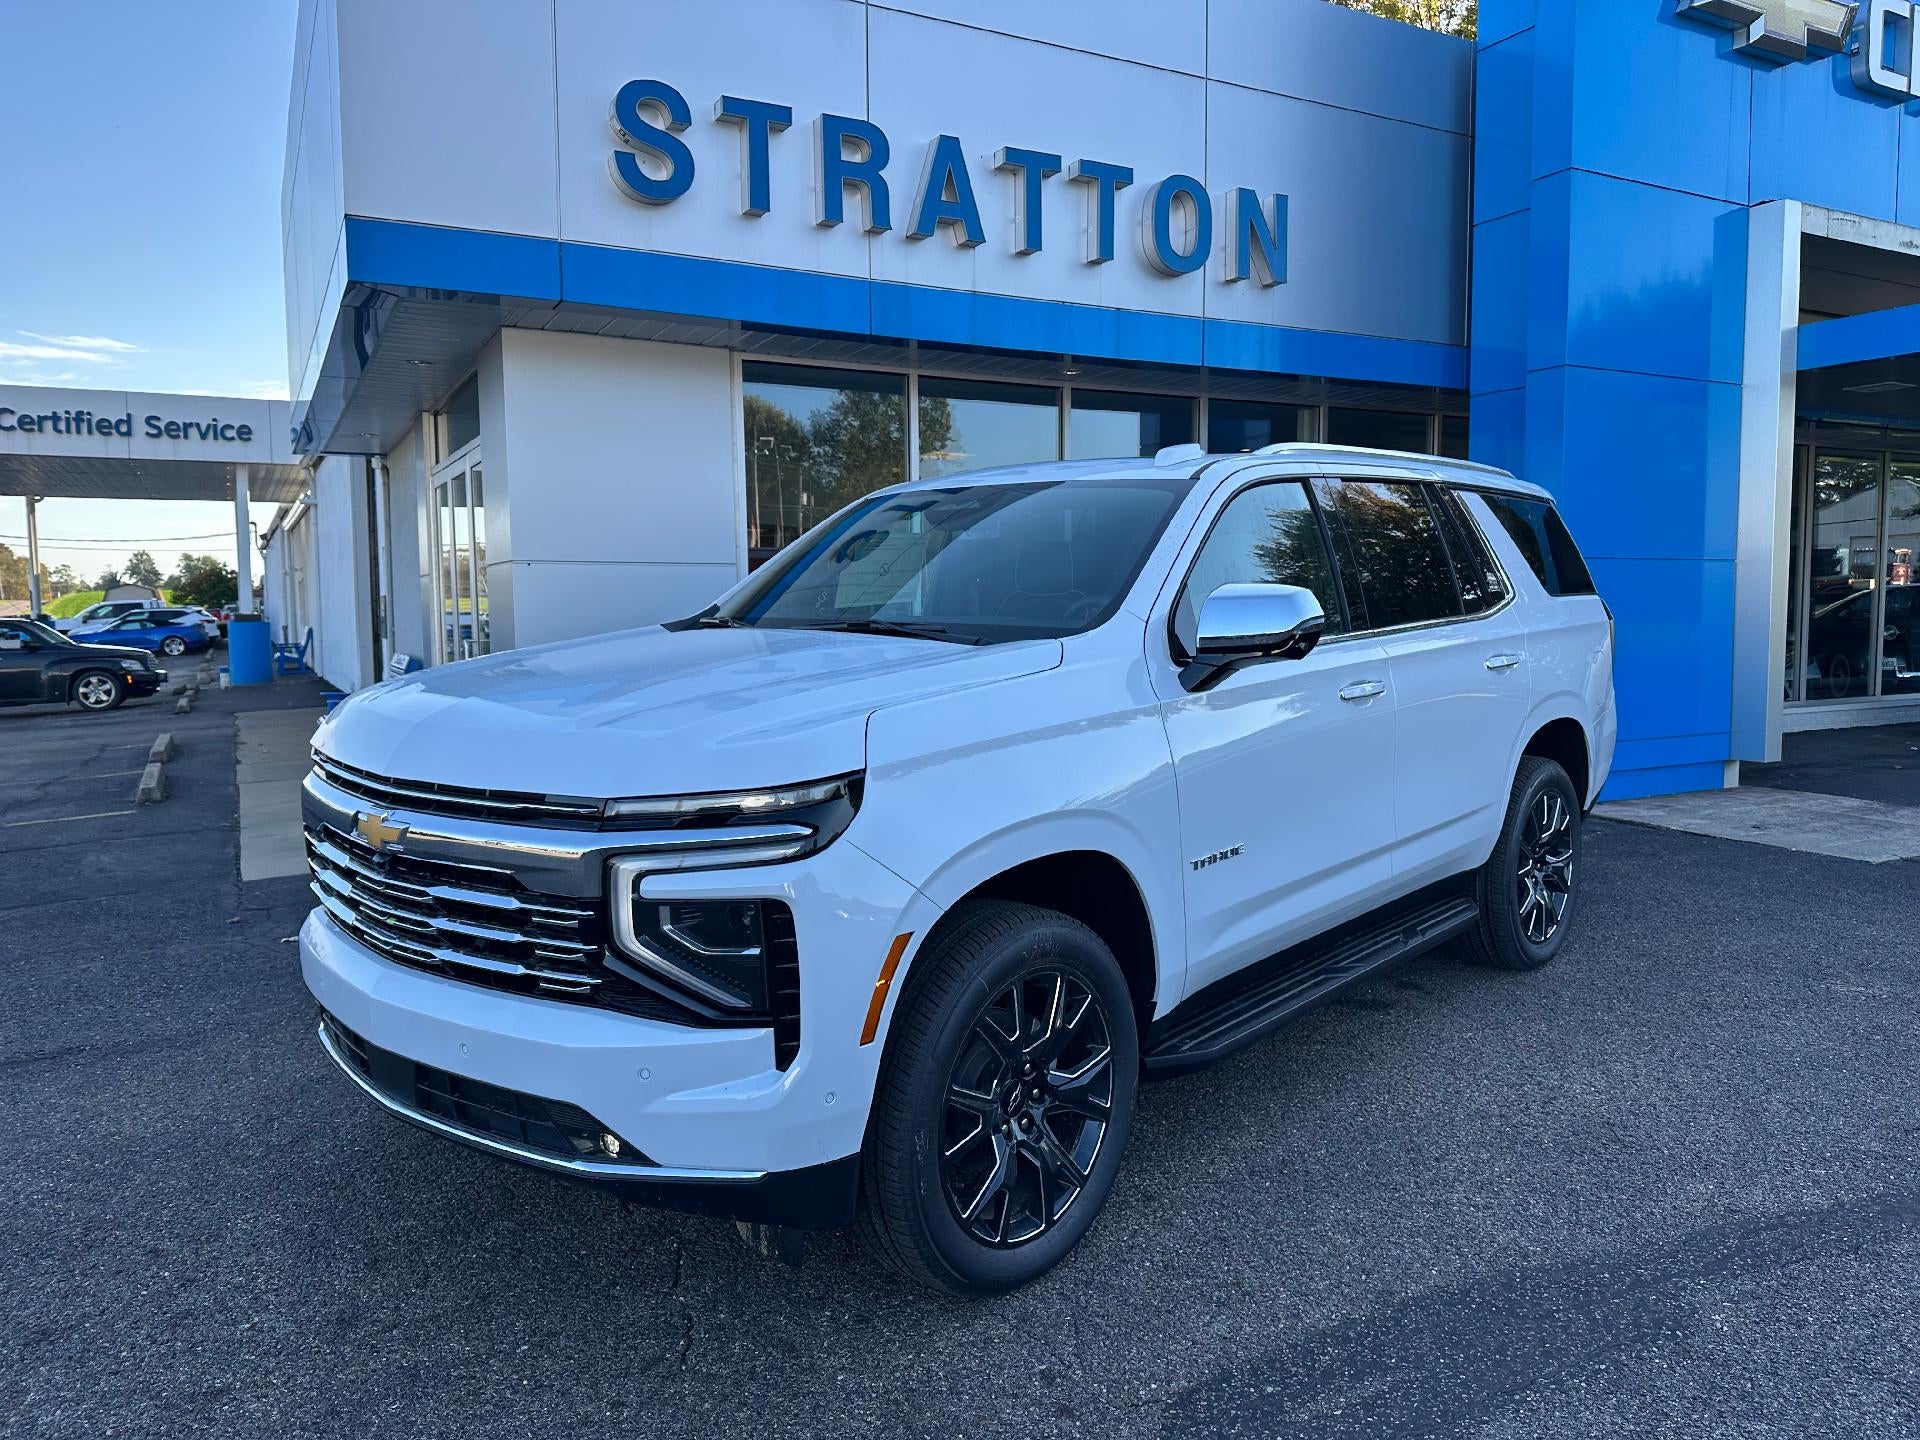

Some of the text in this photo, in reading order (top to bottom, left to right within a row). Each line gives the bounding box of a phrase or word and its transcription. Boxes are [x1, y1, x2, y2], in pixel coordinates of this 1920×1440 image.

[608, 79, 1289, 288] STRATTON
[0, 407, 253, 442] Certified Service
[1189, 842, 1245, 871] TAHOE
